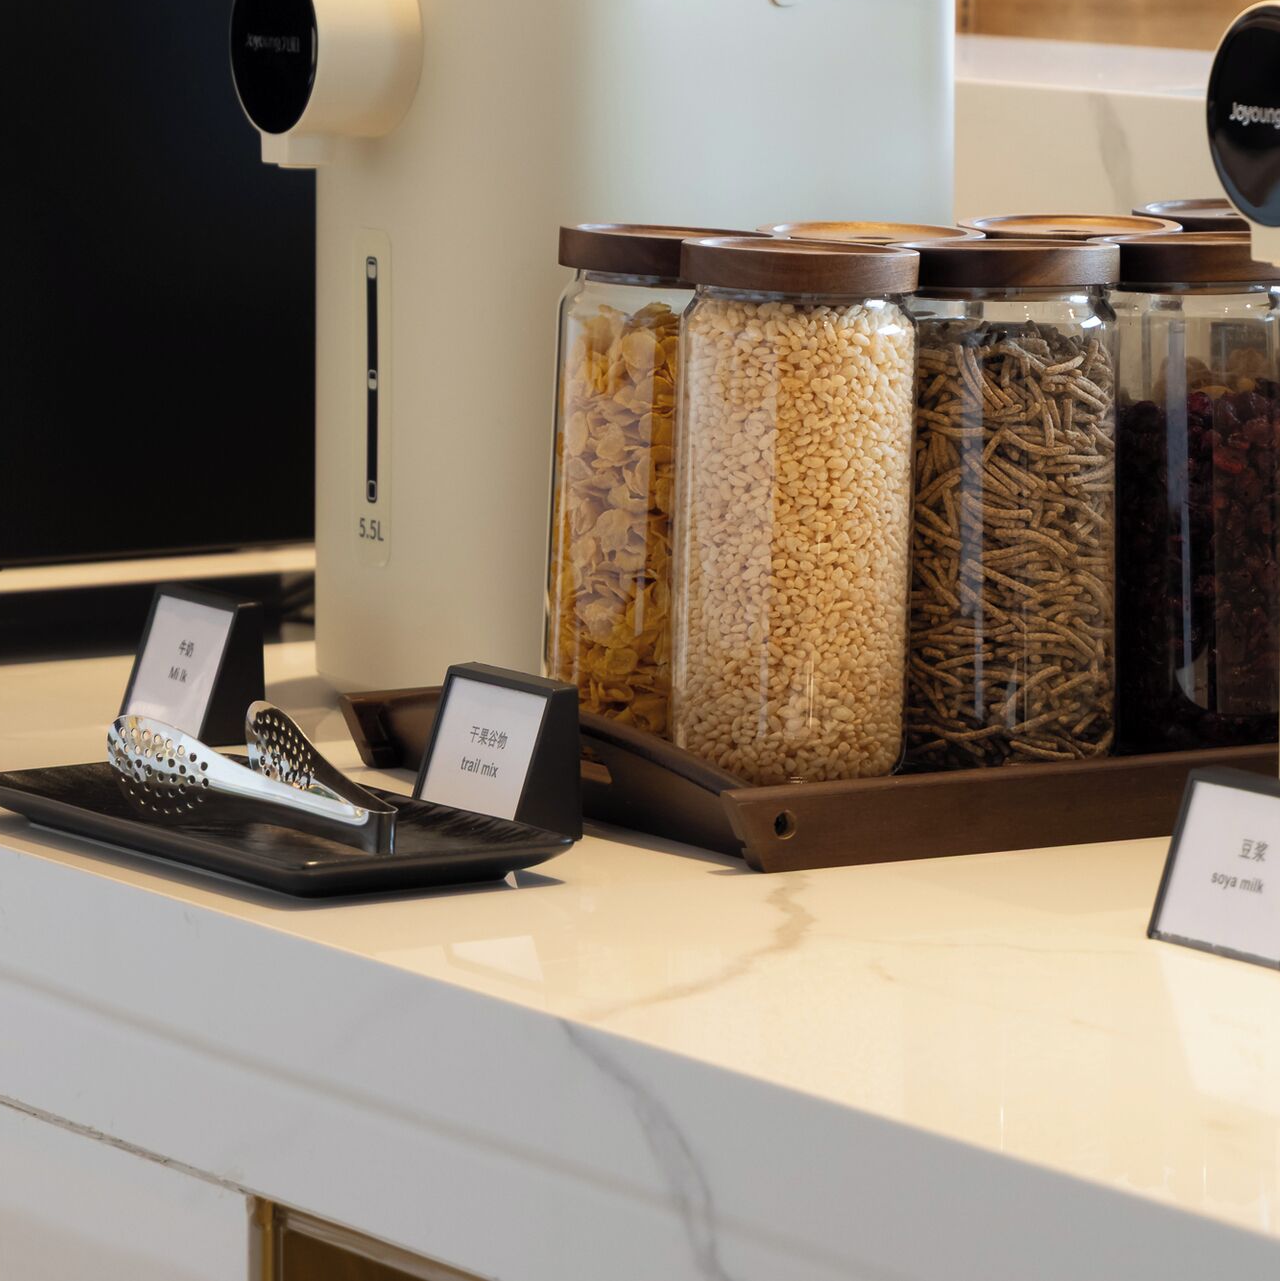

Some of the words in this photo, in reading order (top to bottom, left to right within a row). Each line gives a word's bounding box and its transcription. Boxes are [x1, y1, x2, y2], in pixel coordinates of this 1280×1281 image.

[358, 516, 384, 542] 5.5L
[167, 666, 188, 683] Milk
[469, 725, 508, 750] 干果谷物
[460, 756, 480, 775] trail
[481, 762, 499, 779] mix
[1238, 838, 1270, 862] 豆浆
[1211, 871, 1237, 891] soya
[1239, 876, 1264, 894] milk
